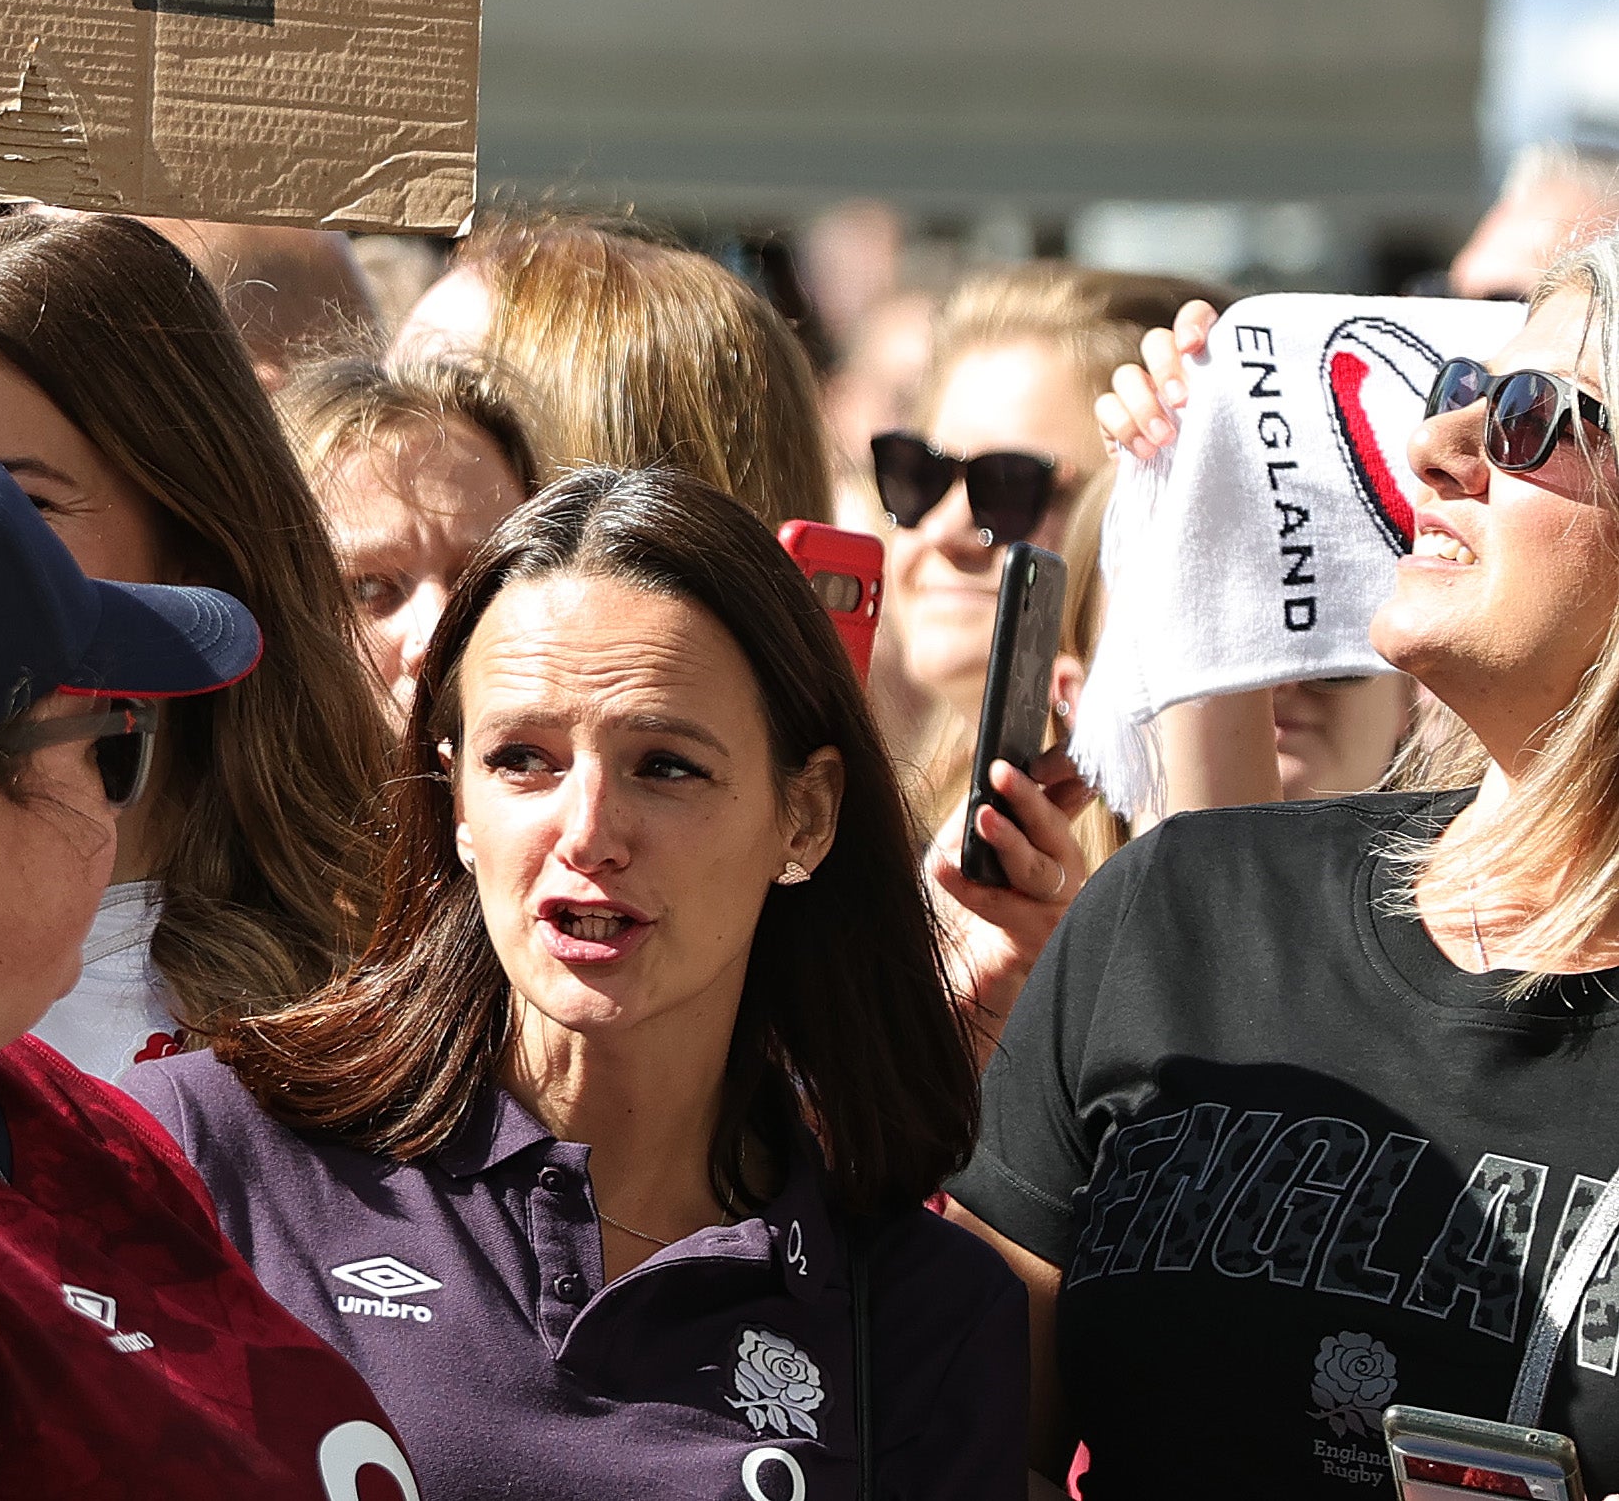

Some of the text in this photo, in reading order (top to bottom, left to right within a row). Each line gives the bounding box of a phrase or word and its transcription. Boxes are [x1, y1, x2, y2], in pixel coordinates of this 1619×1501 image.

[1234, 322, 1317, 633] ENGLAND
[337, 1295, 432, 1323] umbro
[1322, 1459, 1384, 1488] Rugby
